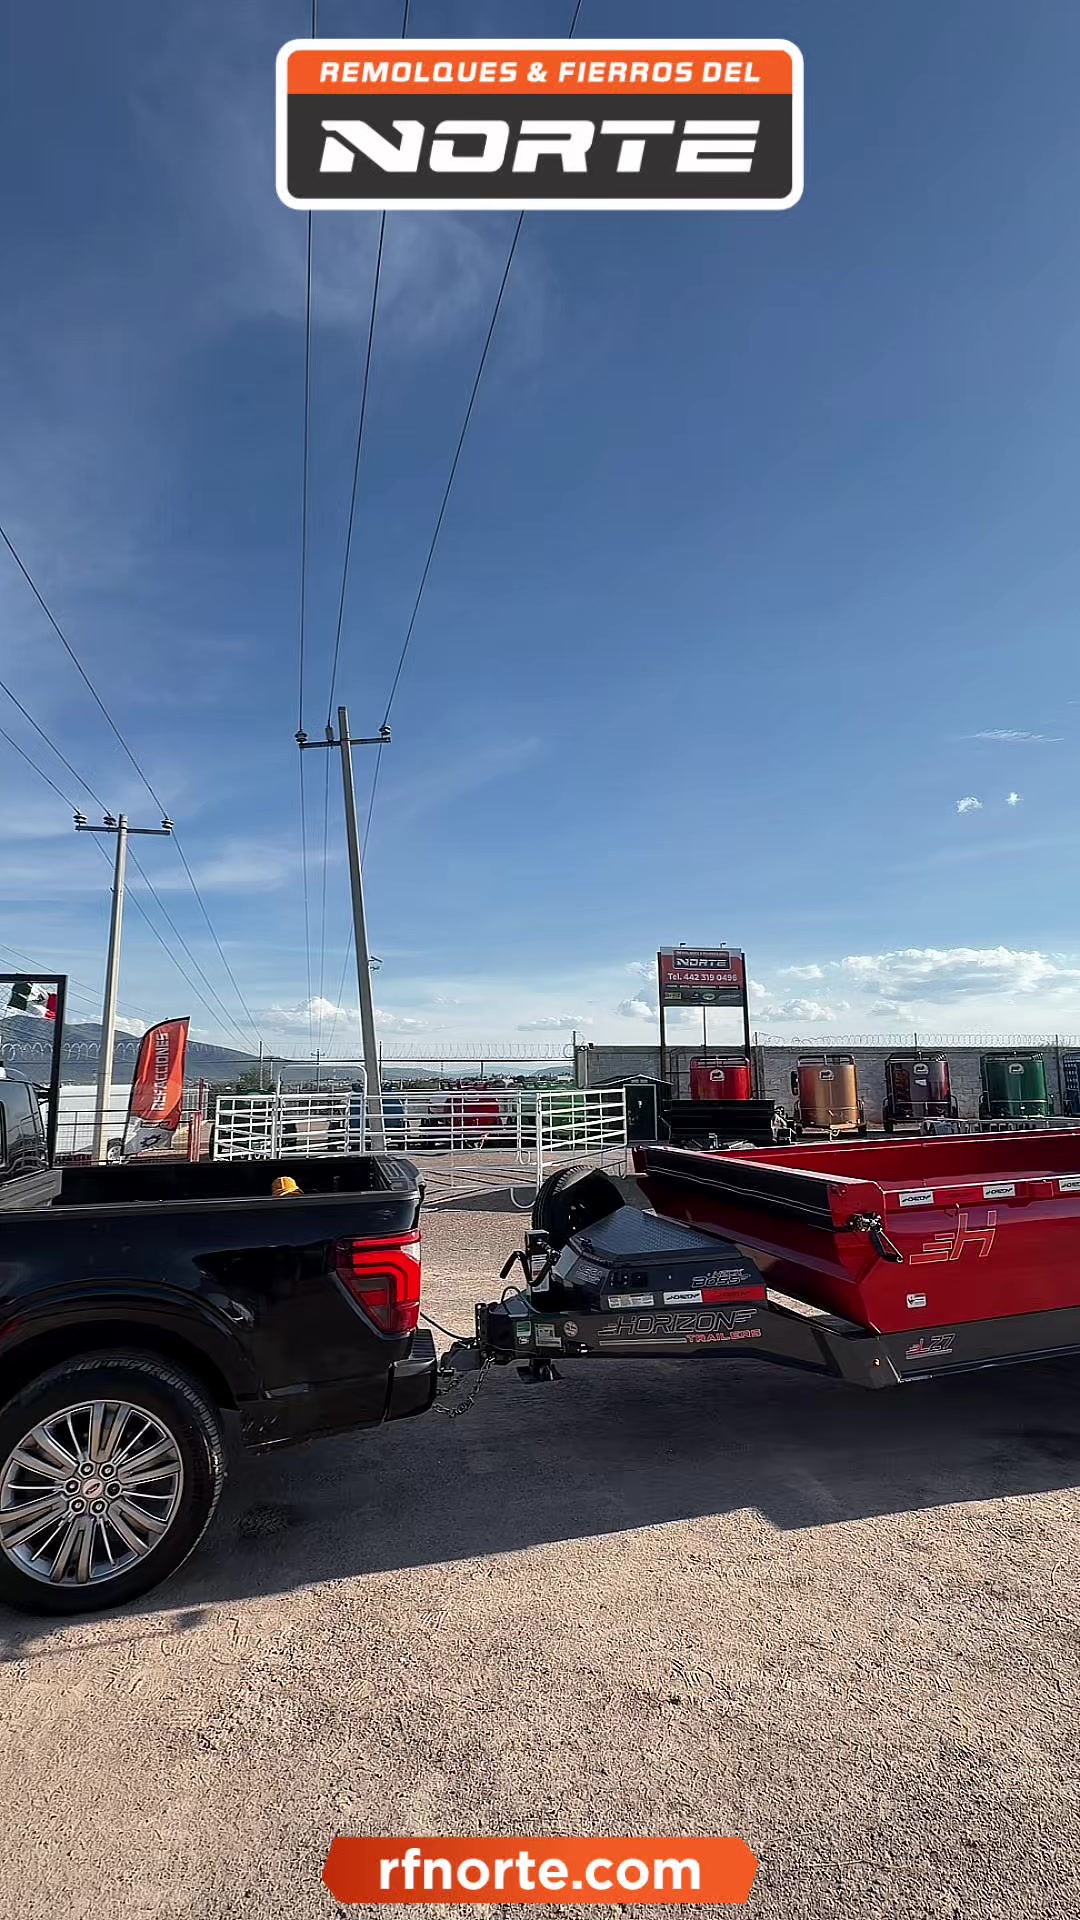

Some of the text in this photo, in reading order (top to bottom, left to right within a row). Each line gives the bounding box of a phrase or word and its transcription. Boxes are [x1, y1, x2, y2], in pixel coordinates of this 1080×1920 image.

[676, 958, 727, 967] NORTE
[667, 972, 682, 981] Tel.
[683, 973, 700, 981] 442
[700, 973, 715, 982] 319
[151, 1032, 169, 1111] REFACCIONES
[613, 1310, 741, 1336] HORIZON
[687, 1329, 762, 1343] TRAILERS
